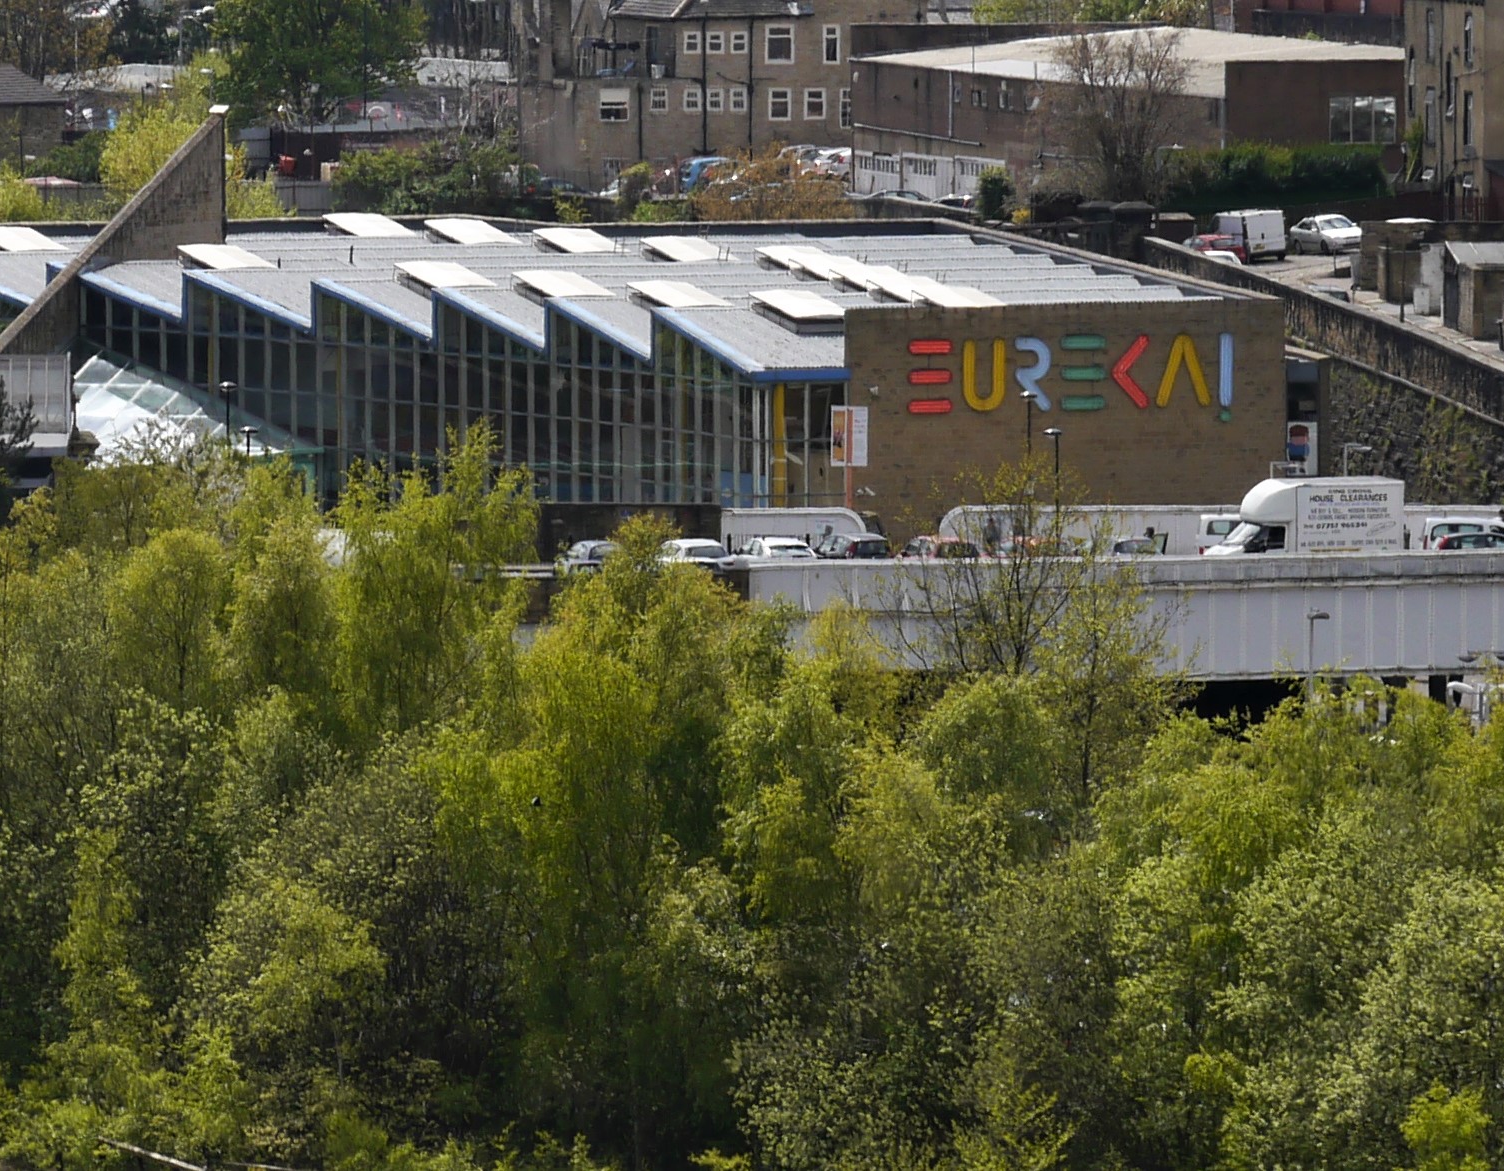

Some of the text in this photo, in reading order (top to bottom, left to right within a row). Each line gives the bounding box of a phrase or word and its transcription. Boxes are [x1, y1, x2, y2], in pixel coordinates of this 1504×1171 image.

[908, 331, 1234, 422] EUREKA!
[1309, 493, 1388, 502] HOUSE CLEARANCES
